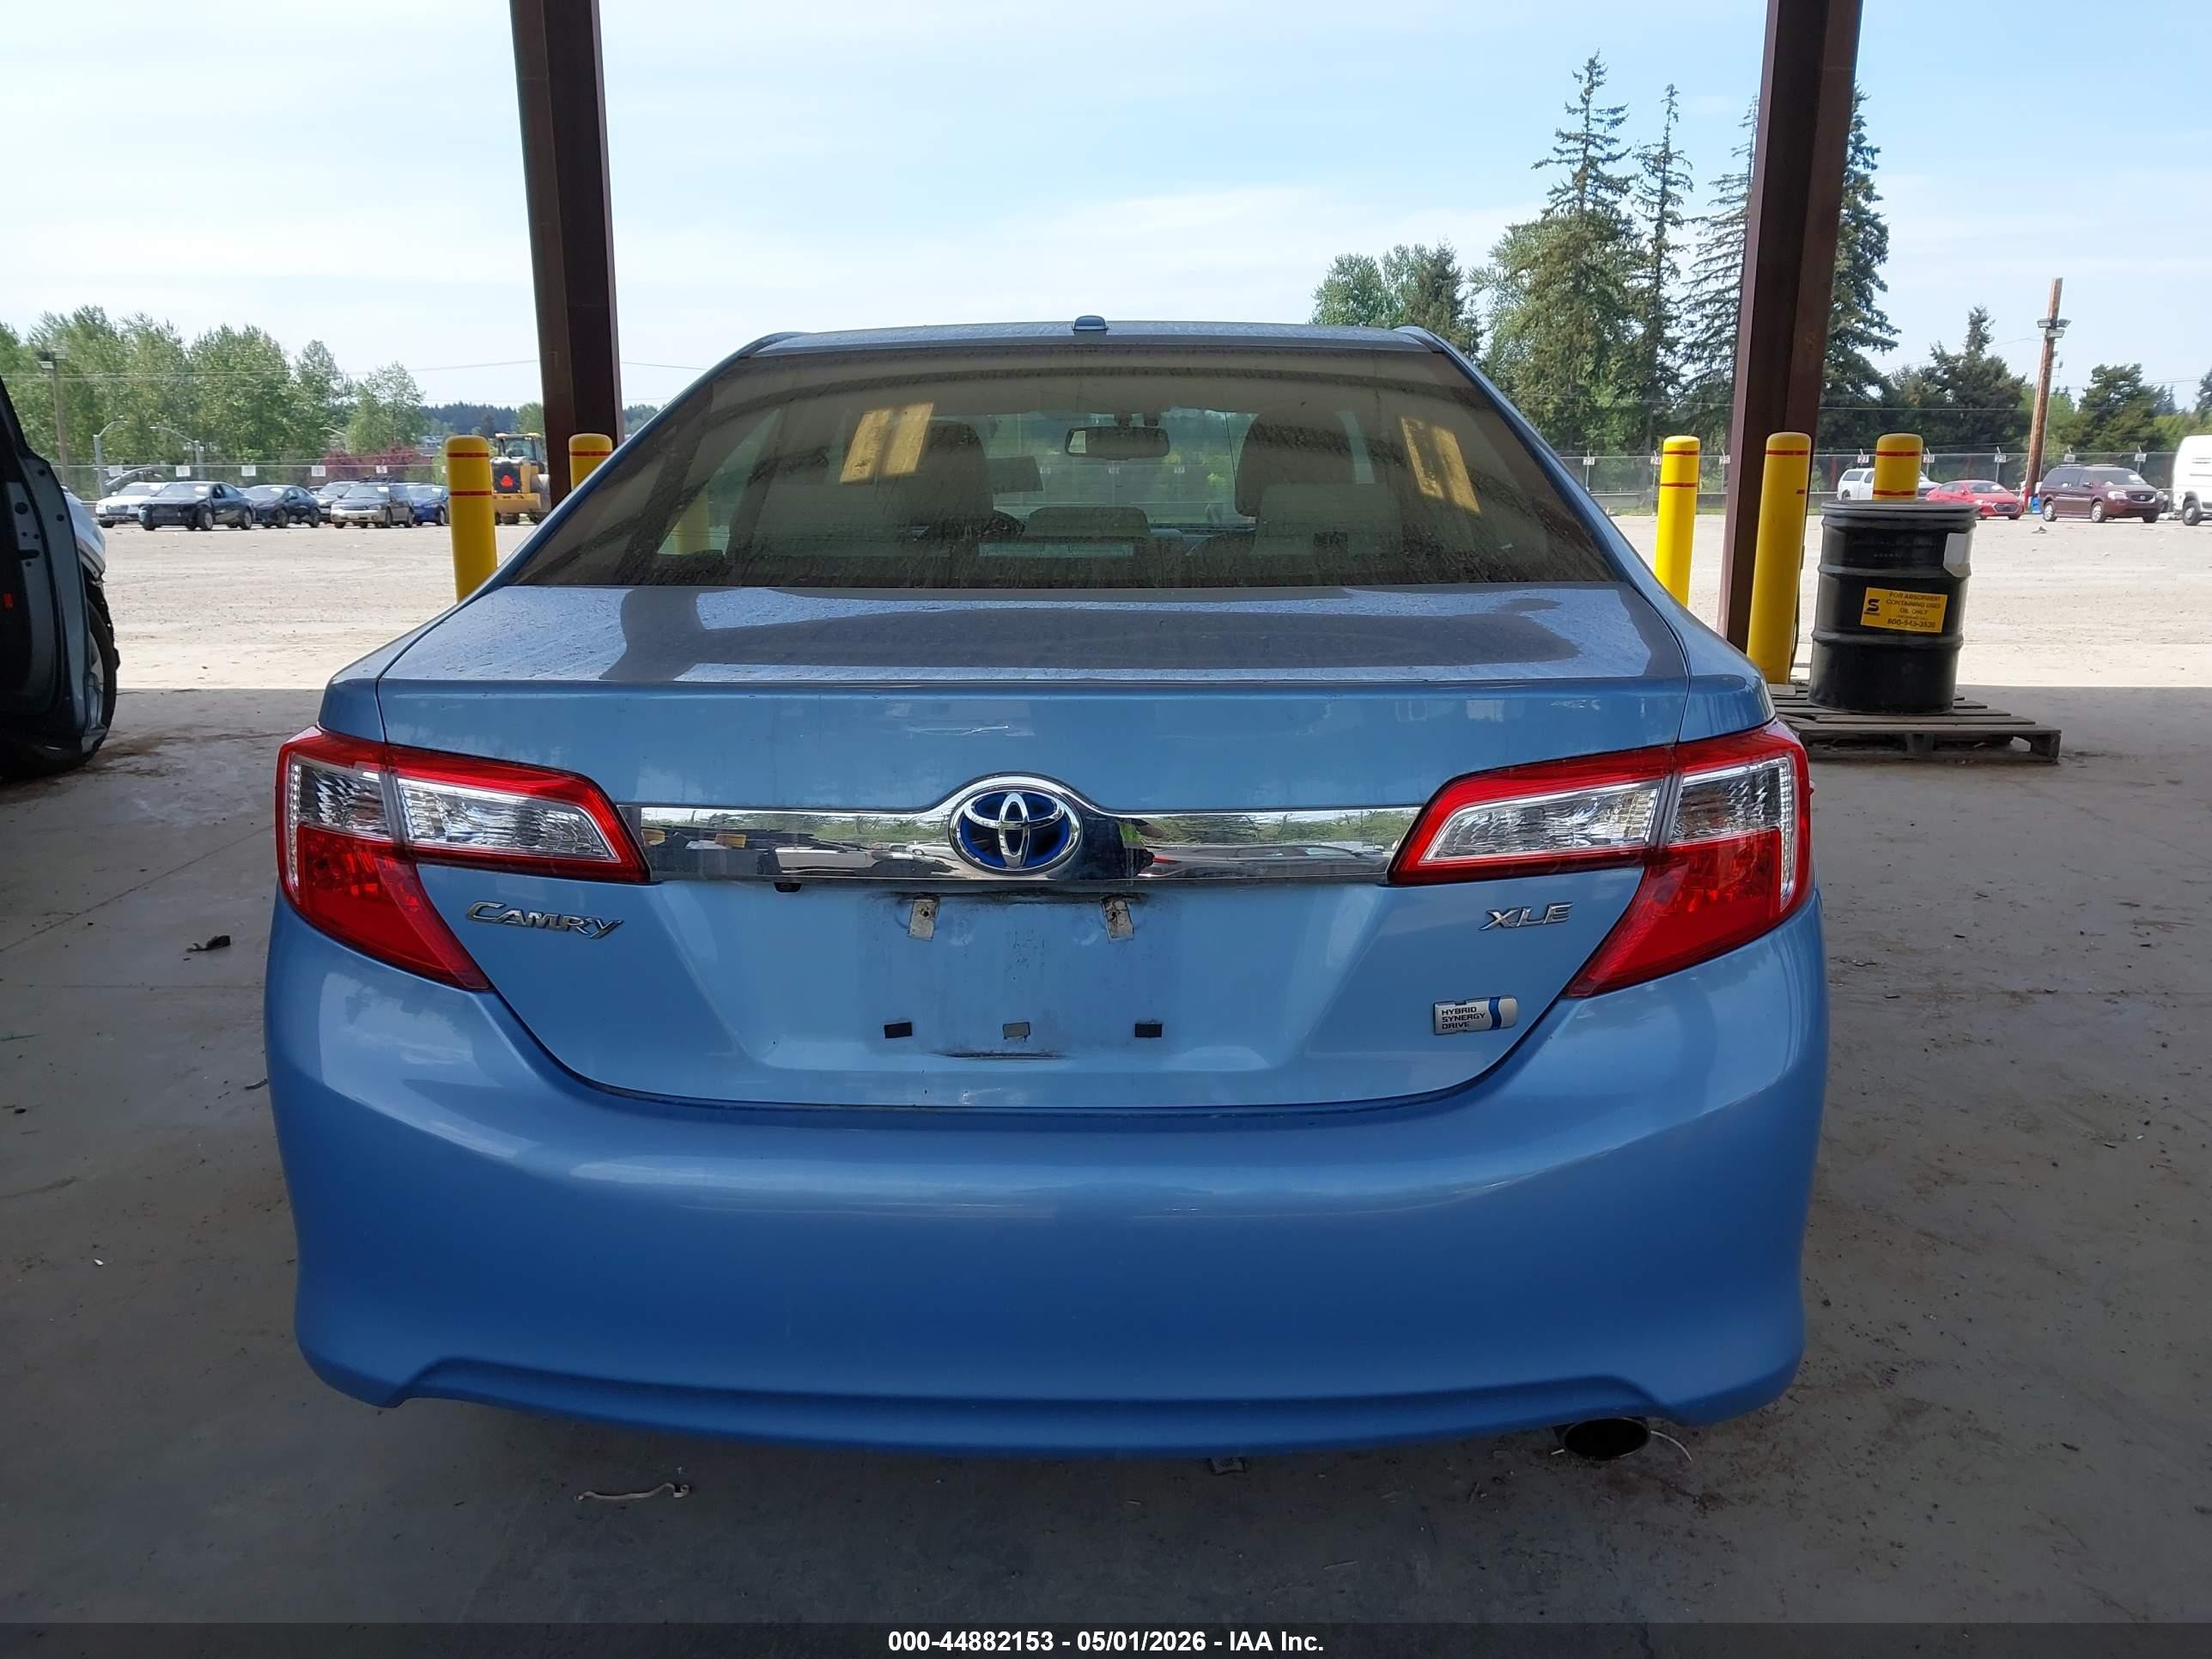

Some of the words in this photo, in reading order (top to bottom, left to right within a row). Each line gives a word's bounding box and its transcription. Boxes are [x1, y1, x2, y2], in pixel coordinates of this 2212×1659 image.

[1886, 599, 1925, 607] CONTAINING
[467, 901, 623, 939] CAMRY
[1478, 902, 1574, 931] XLE
[1442, 1006, 1477, 1016] HYBRID
[1442, 1012, 1486, 1024] SYNERGY
[1442, 1021, 1470, 1030] DRIVE
